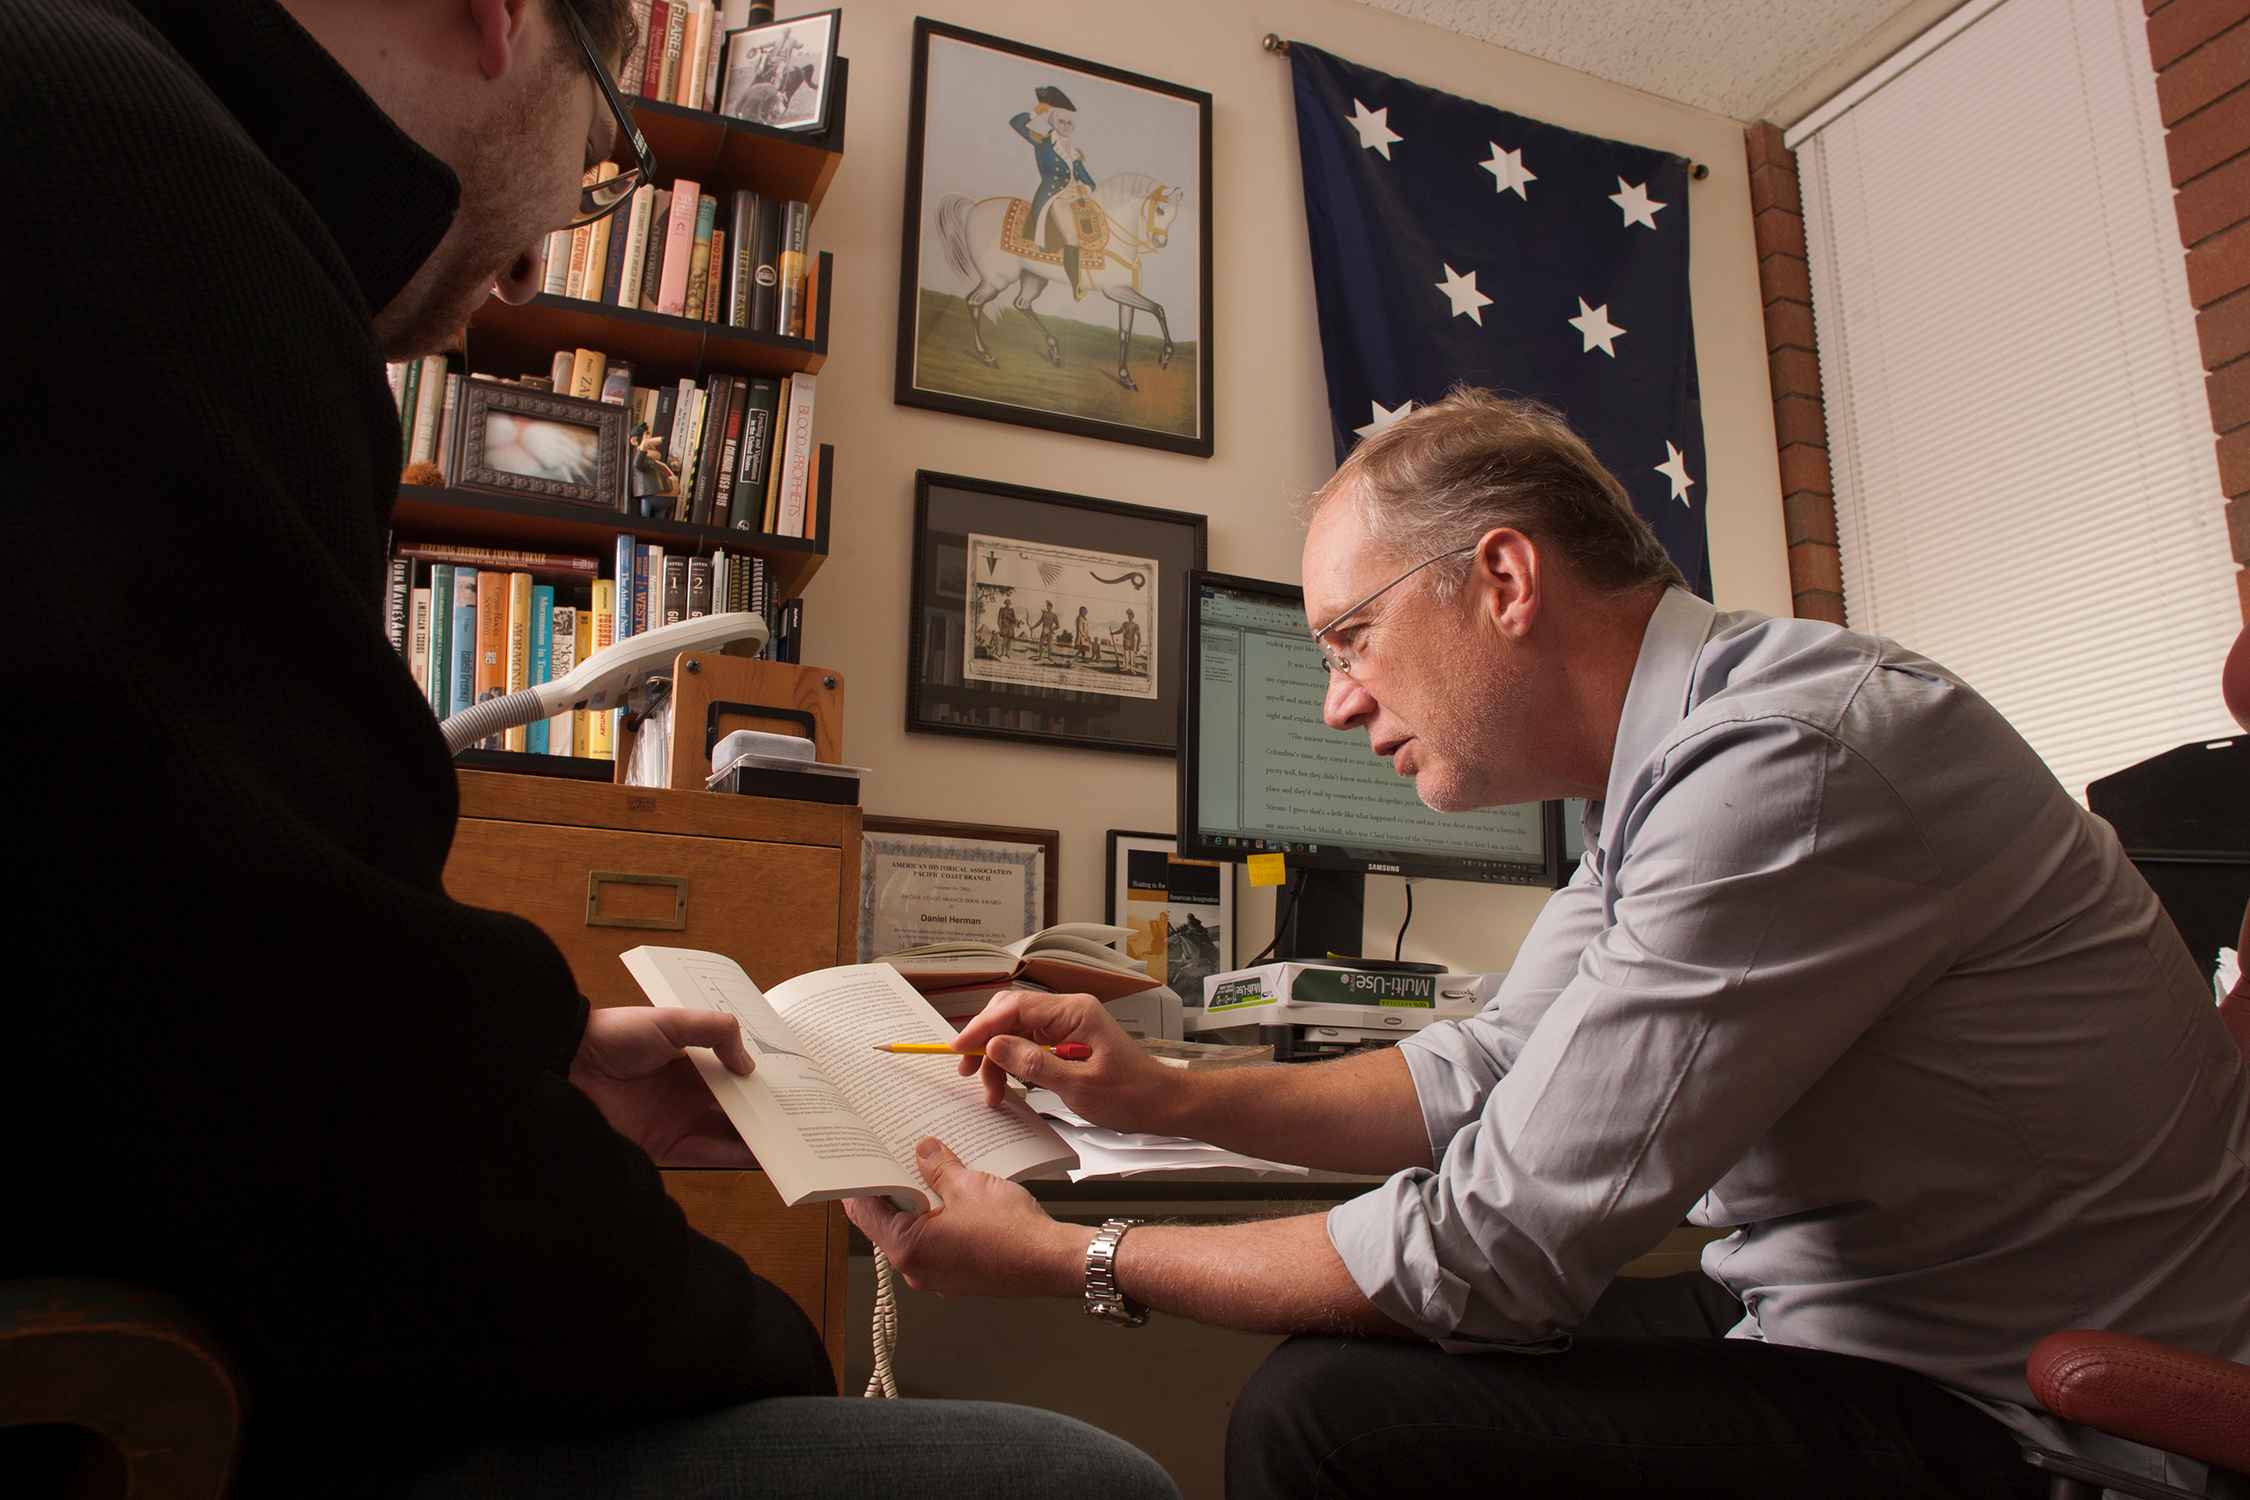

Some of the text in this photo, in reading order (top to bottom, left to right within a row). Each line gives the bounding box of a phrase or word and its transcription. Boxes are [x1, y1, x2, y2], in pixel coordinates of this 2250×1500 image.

[667, 3, 687, 61] FILAREE
[735, 294, 747, 327] RANG
[391, 559, 408, 582] JOHN
[671, 576, 677, 589] 1
[693, 577, 703, 589] 2
[416, 601, 427, 630] AMERICAN
[511, 622, 524, 693] MORMONIS
[537, 648, 546, 658] in
[892, 862, 928, 871] AMERICAN
[1368, 863, 1400, 872] SAMSUNG
[920, 913, 982, 925] Daniel Herman
[1356, 974, 1431, 997] Multi-Use
